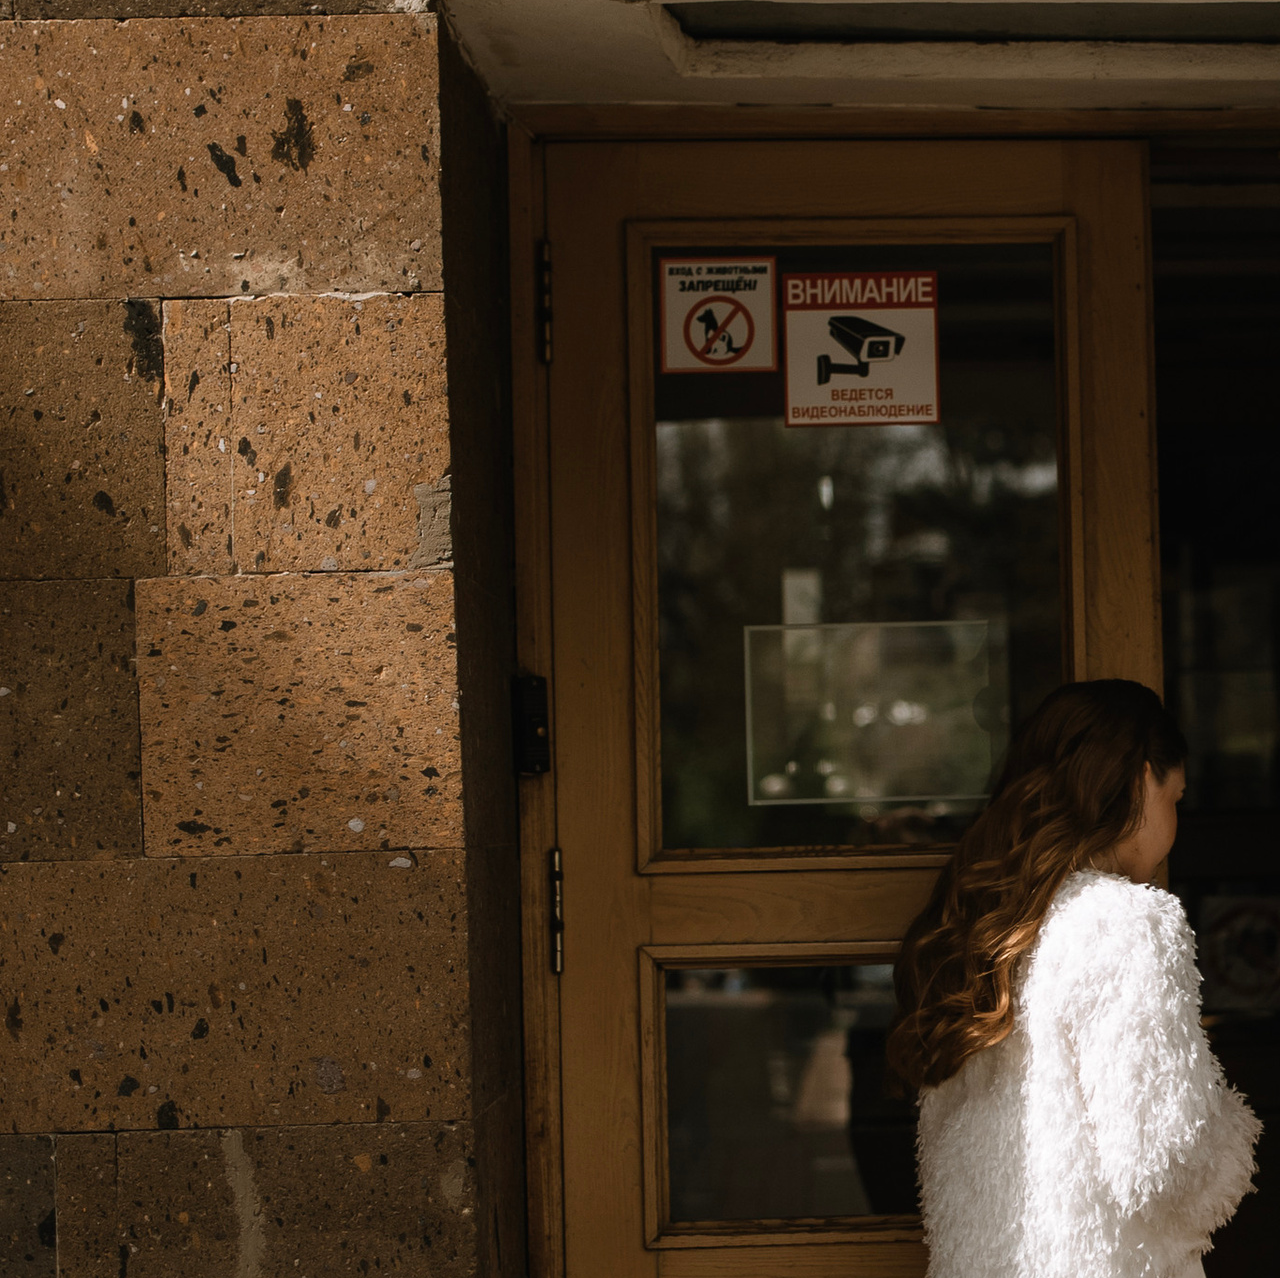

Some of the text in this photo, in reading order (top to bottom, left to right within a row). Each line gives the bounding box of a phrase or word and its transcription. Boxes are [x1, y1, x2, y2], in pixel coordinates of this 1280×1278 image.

[787, 276, 934, 305] ВНИМАНИЕ
[830, 387, 894, 403] ВЕДЕТСЯ
[791, 403, 933, 420] ВИДЕОНАБЛЮДЕНИЕ
